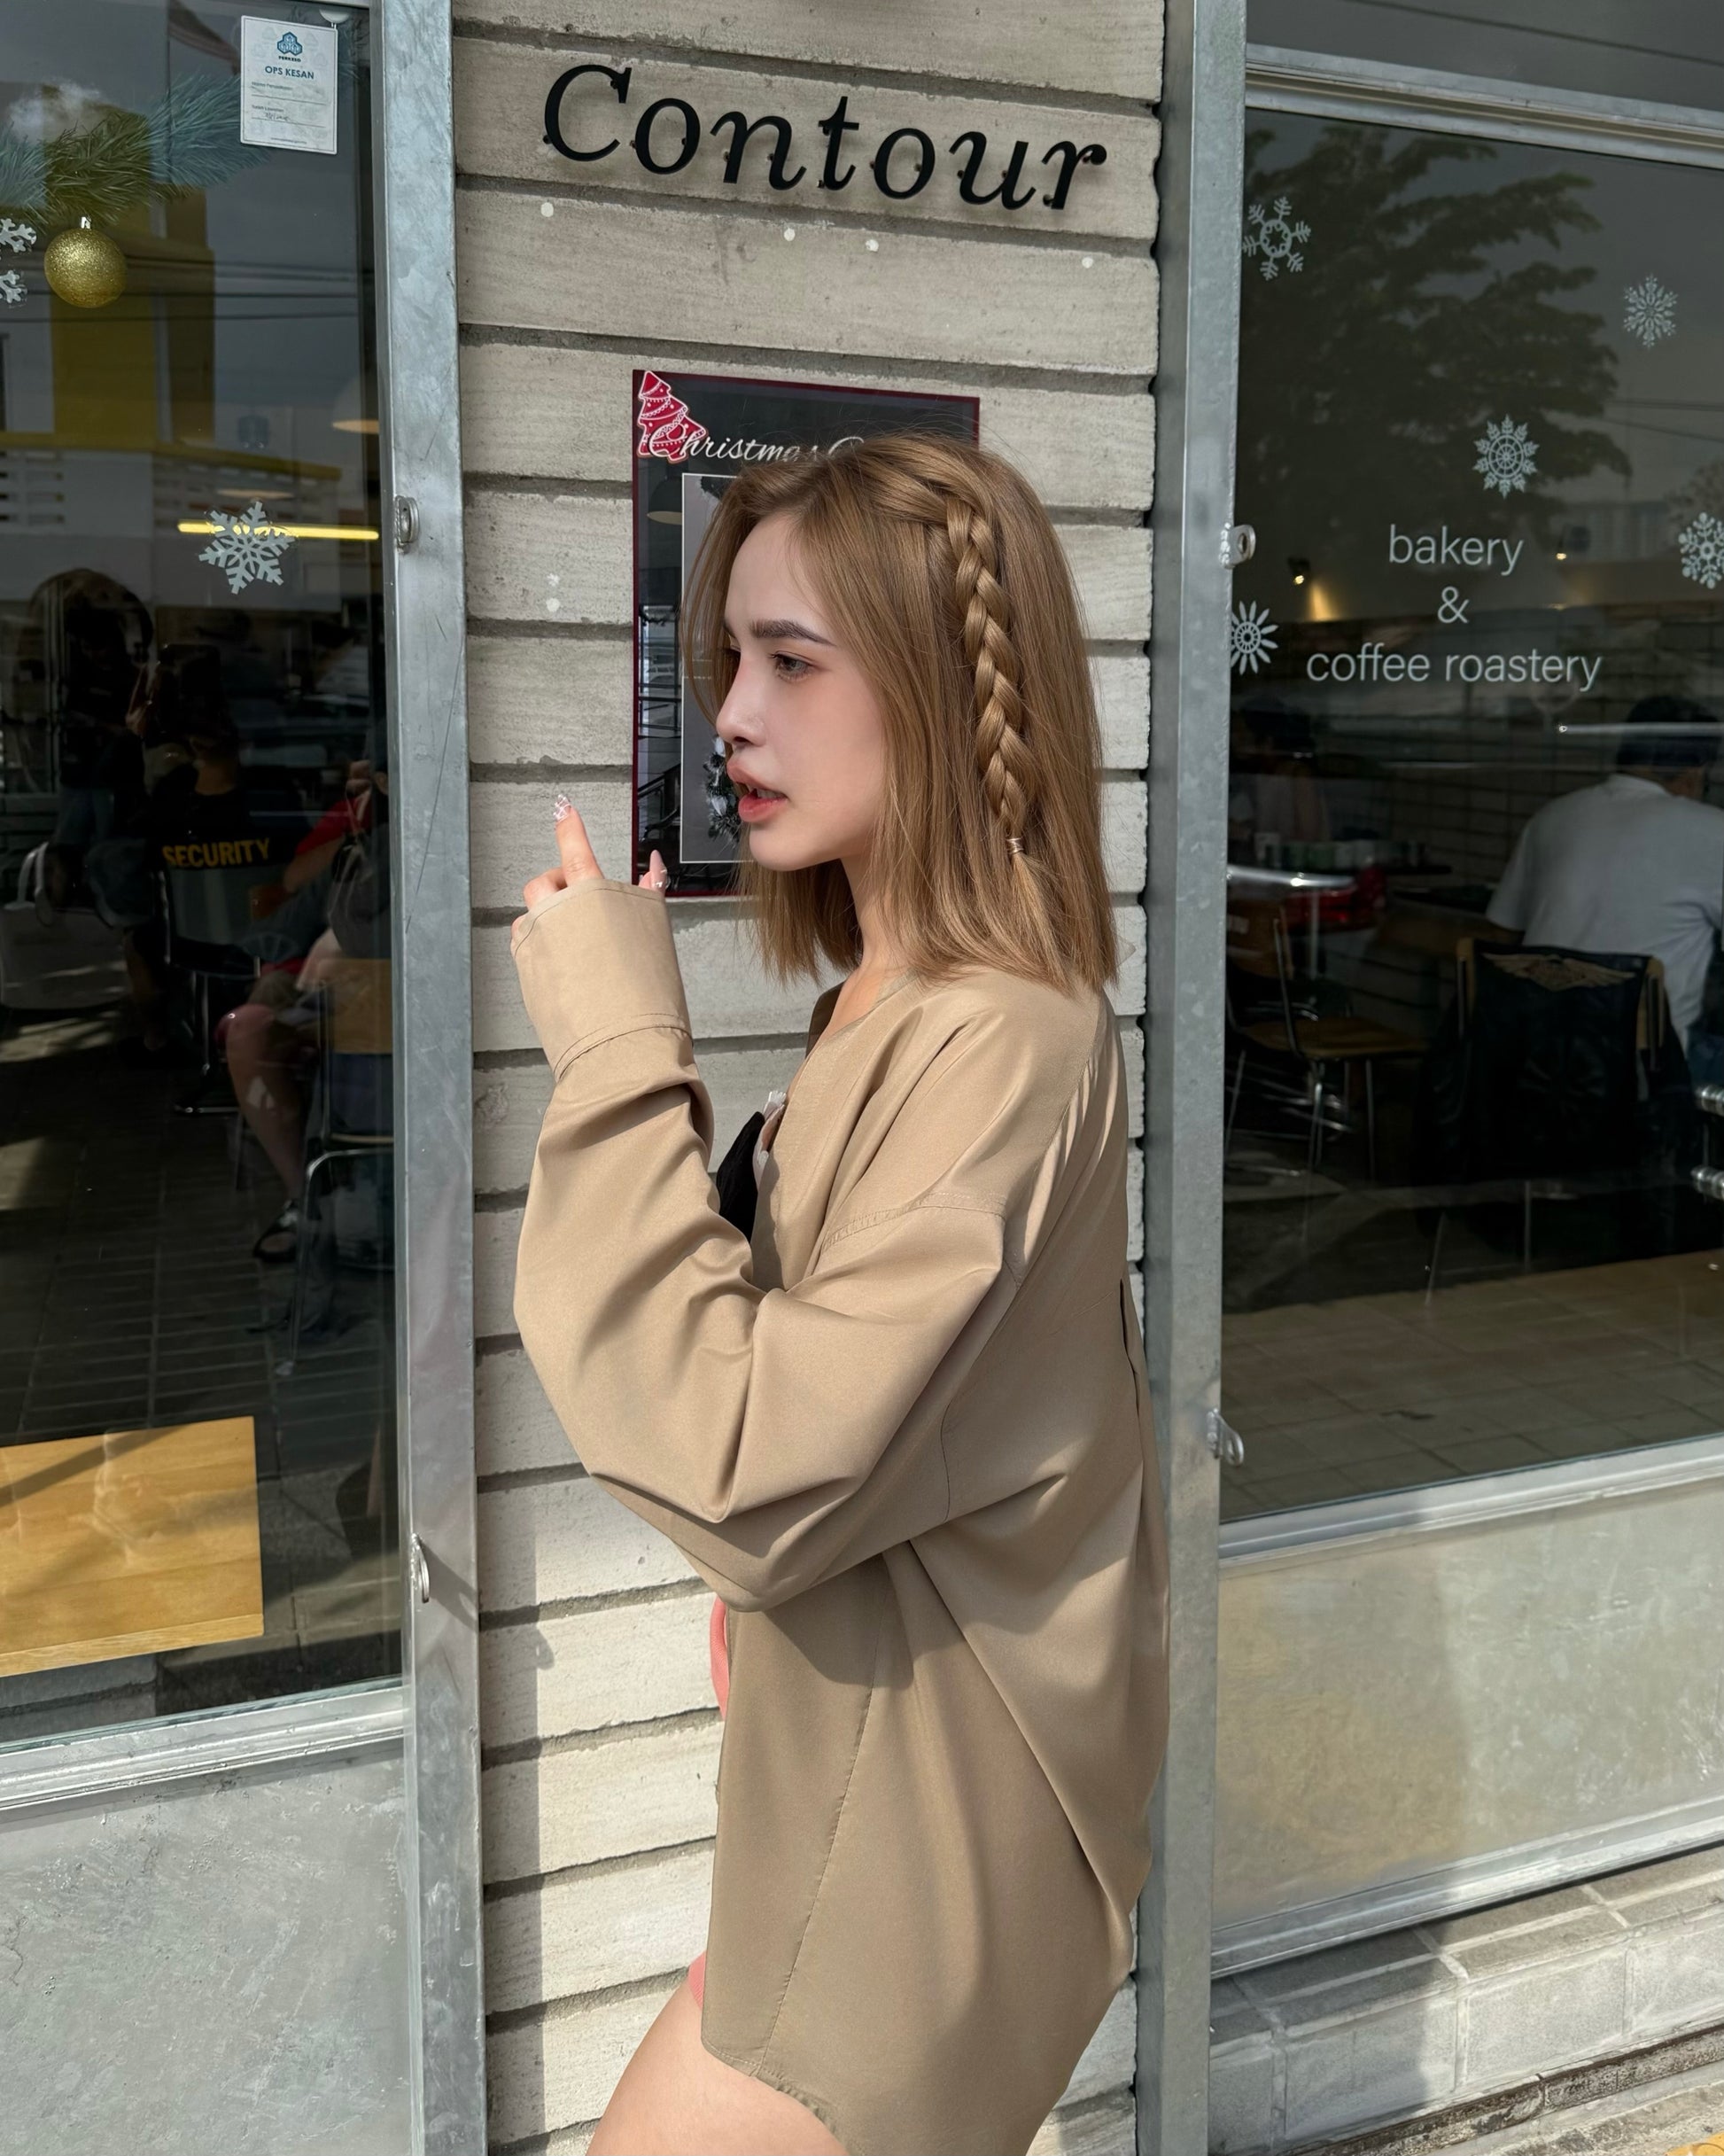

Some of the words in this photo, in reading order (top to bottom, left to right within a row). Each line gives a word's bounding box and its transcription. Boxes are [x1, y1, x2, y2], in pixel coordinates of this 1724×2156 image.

[265, 66, 283, 75] OPS
[285, 68, 315, 79] KESAN
[543, 64, 1107, 210] Contour
[1388, 524, 1524, 576] bakery
[1437, 587, 1470, 623] &
[1307, 642, 1431, 681] coffee
[1445, 649, 1602, 692] roastery
[161, 837, 269, 868] SECURITY
